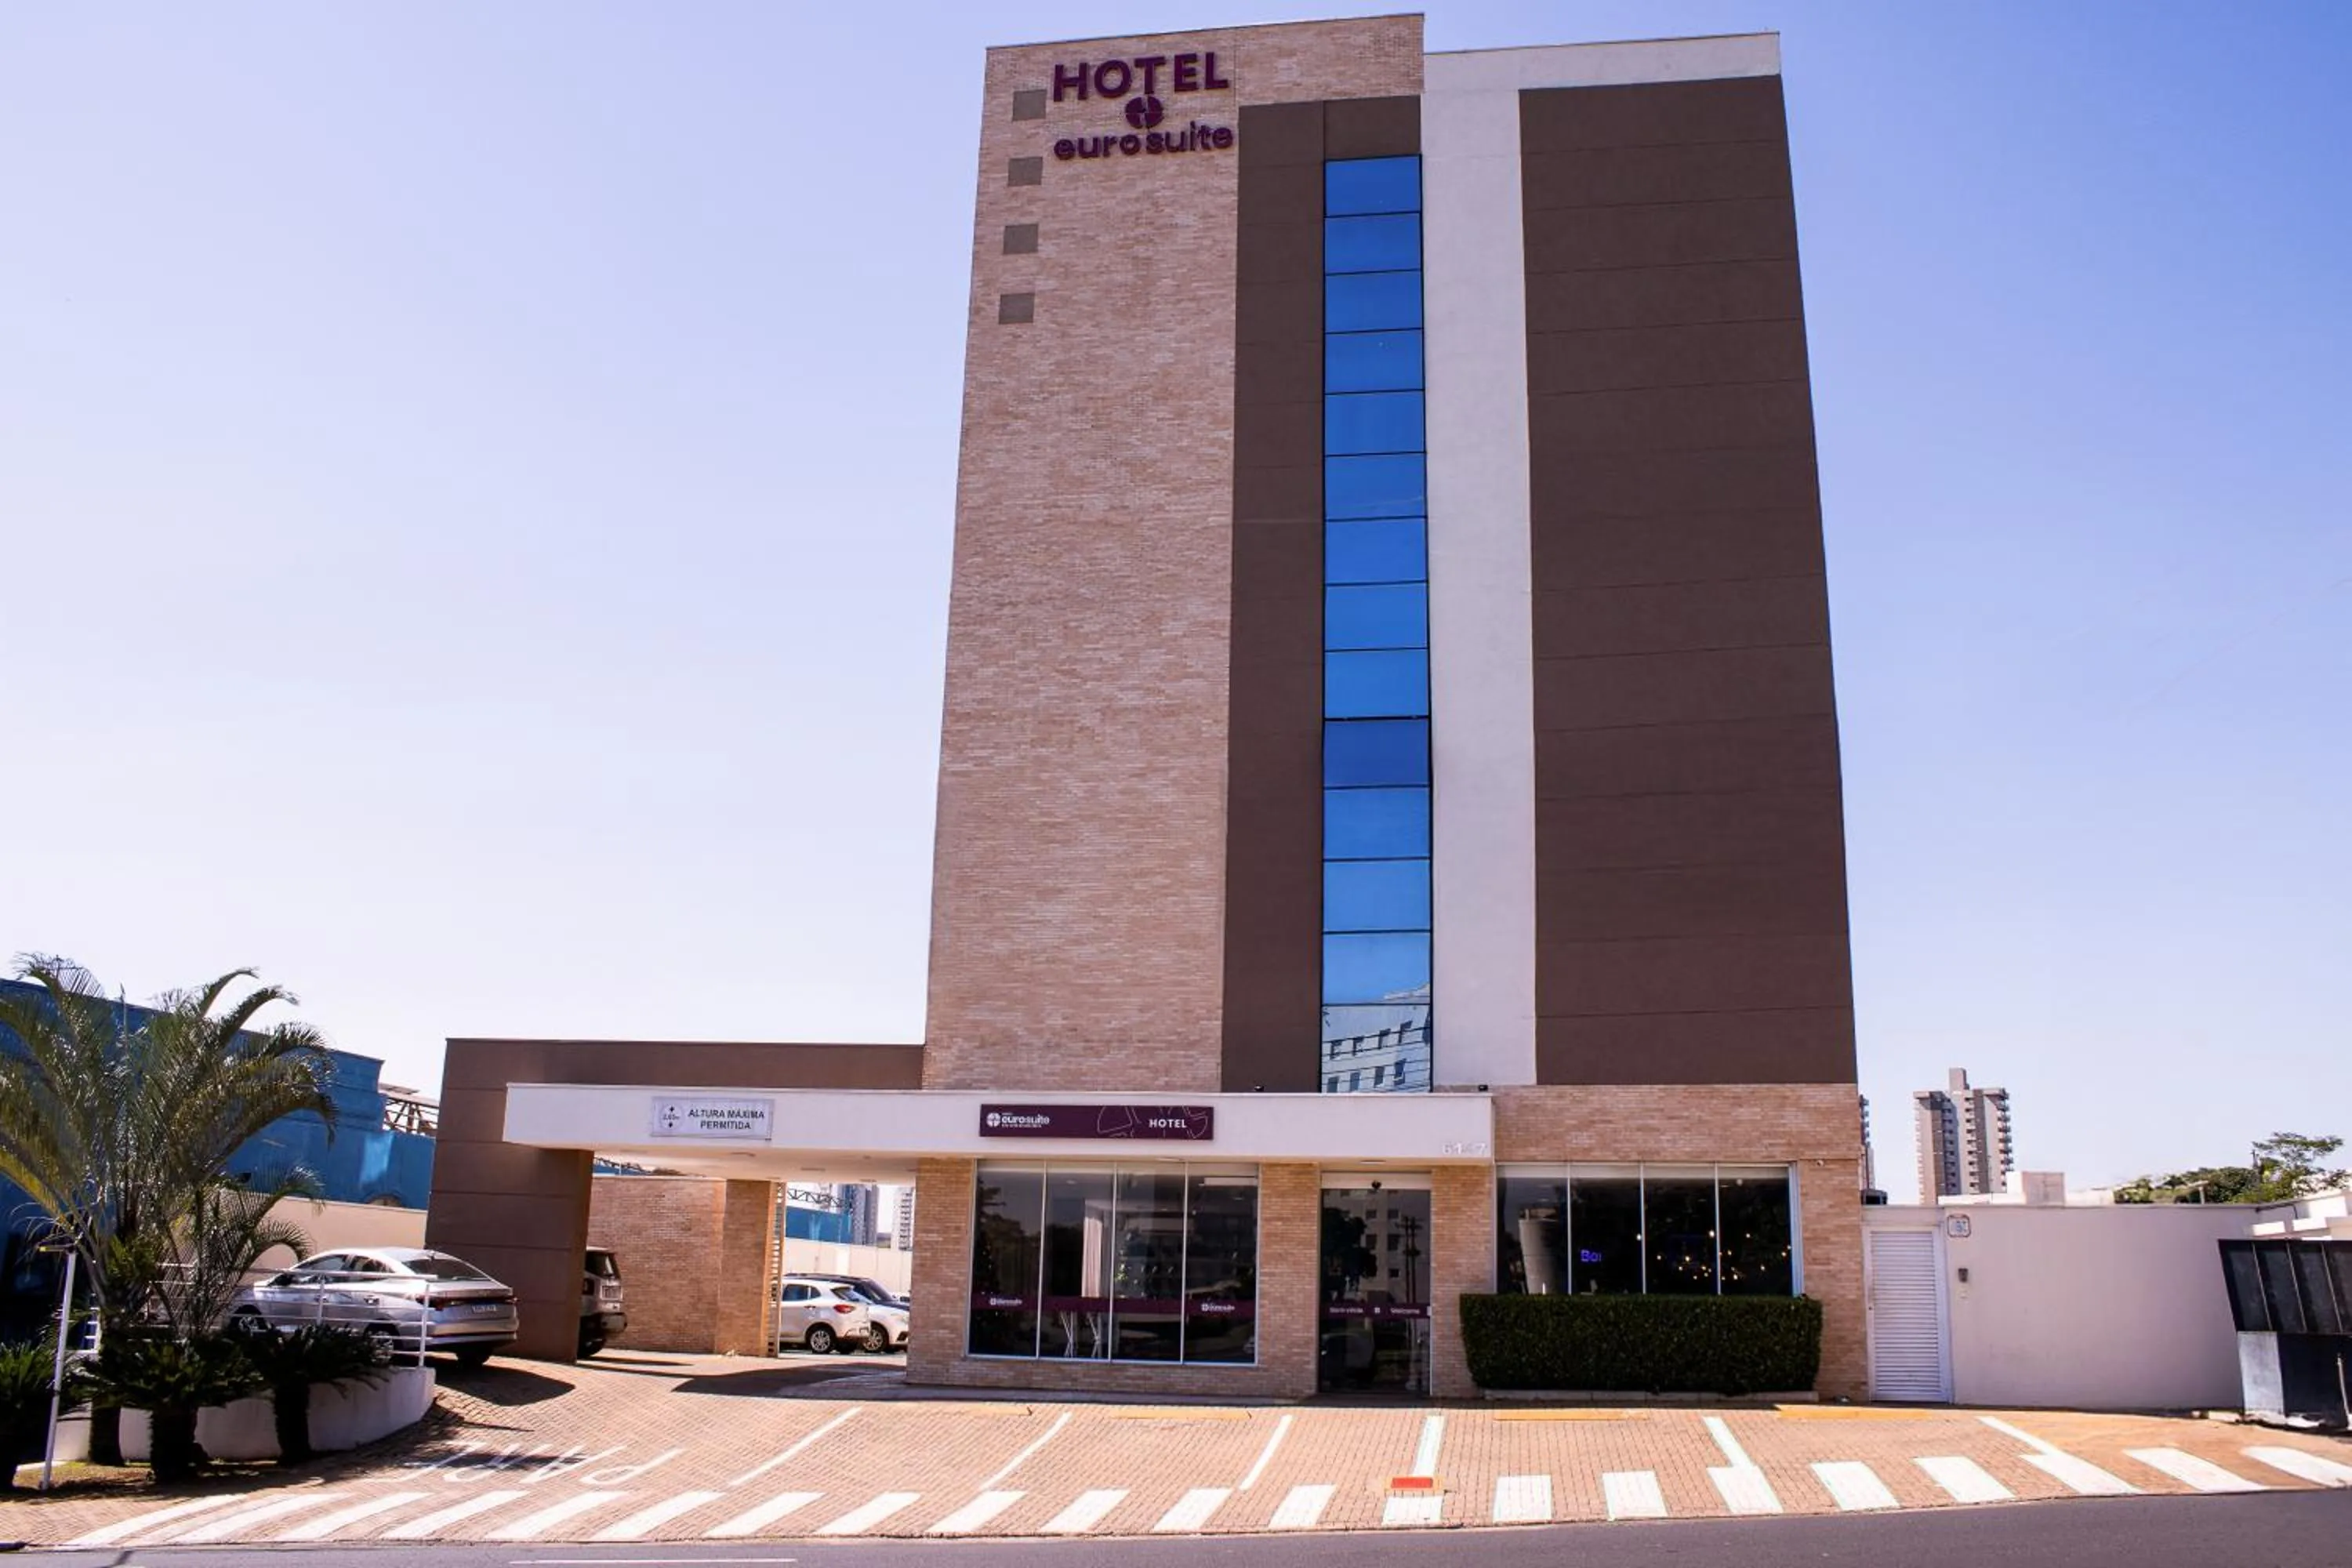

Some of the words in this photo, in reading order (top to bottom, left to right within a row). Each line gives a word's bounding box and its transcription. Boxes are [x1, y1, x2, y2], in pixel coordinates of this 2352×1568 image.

[1053, 52, 1229, 102] HOTEL
[1054, 121, 1233, 160] eurosuite
[688, 1109, 725, 1119] ALTURA
[727, 1107, 765, 1120] MÁXIMA
[1001, 1113, 1050, 1124] eurosuite
[700, 1120, 751, 1130] PERMITIDA
[1149, 1118, 1188, 1128] HOTEL
